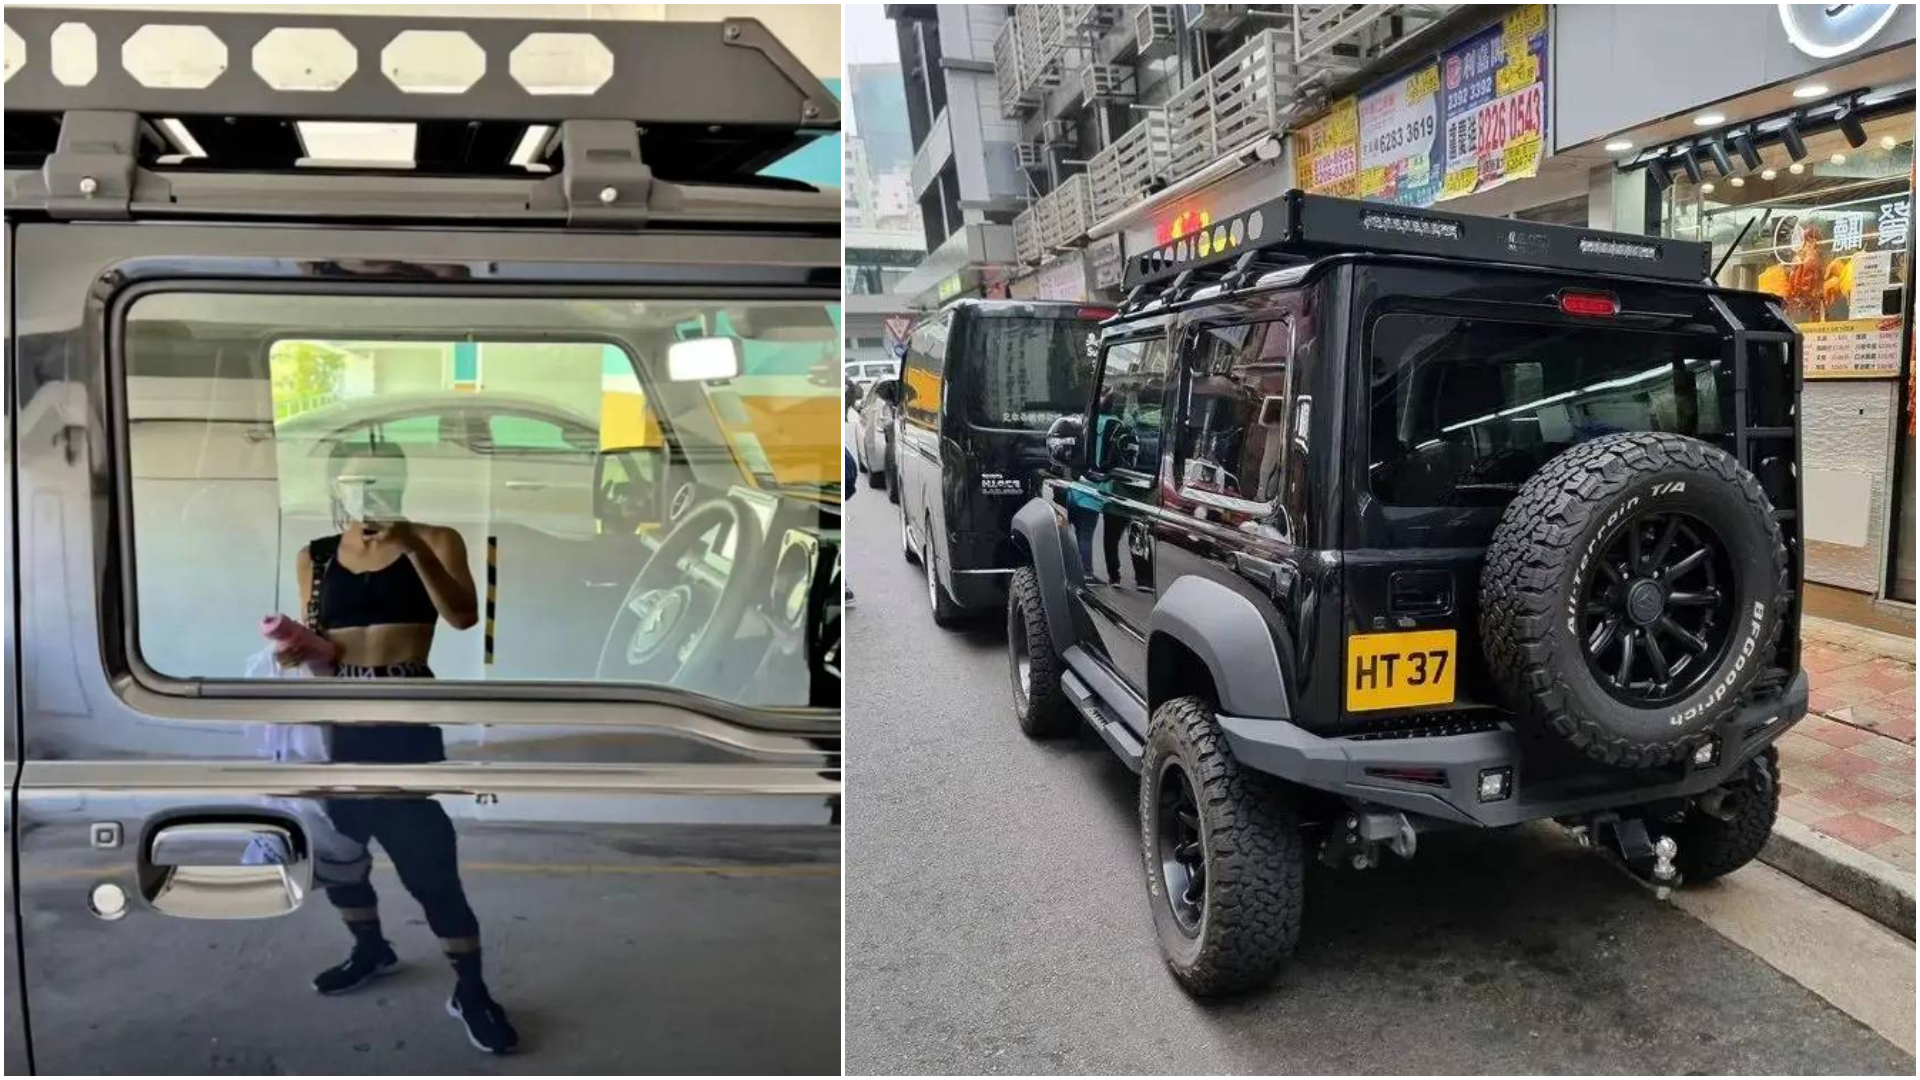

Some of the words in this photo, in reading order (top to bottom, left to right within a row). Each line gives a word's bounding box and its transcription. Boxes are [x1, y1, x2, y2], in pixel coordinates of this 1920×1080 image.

[1447, 87, 1469, 111] 2392
[1470, 76, 1492, 101] 3392
[1379, 126, 1404, 154] 6283
[1406, 115, 1434, 143] 3619
[1478, 102, 1506, 152] 8226
[1567, 495, 1640, 635] All-Terrain
[1651, 480, 1686, 496] T/A
[1356, 652, 1401, 690] HT
[1406, 649, 1449, 686] 37
[1670, 601, 1765, 726] BFGoodrich
